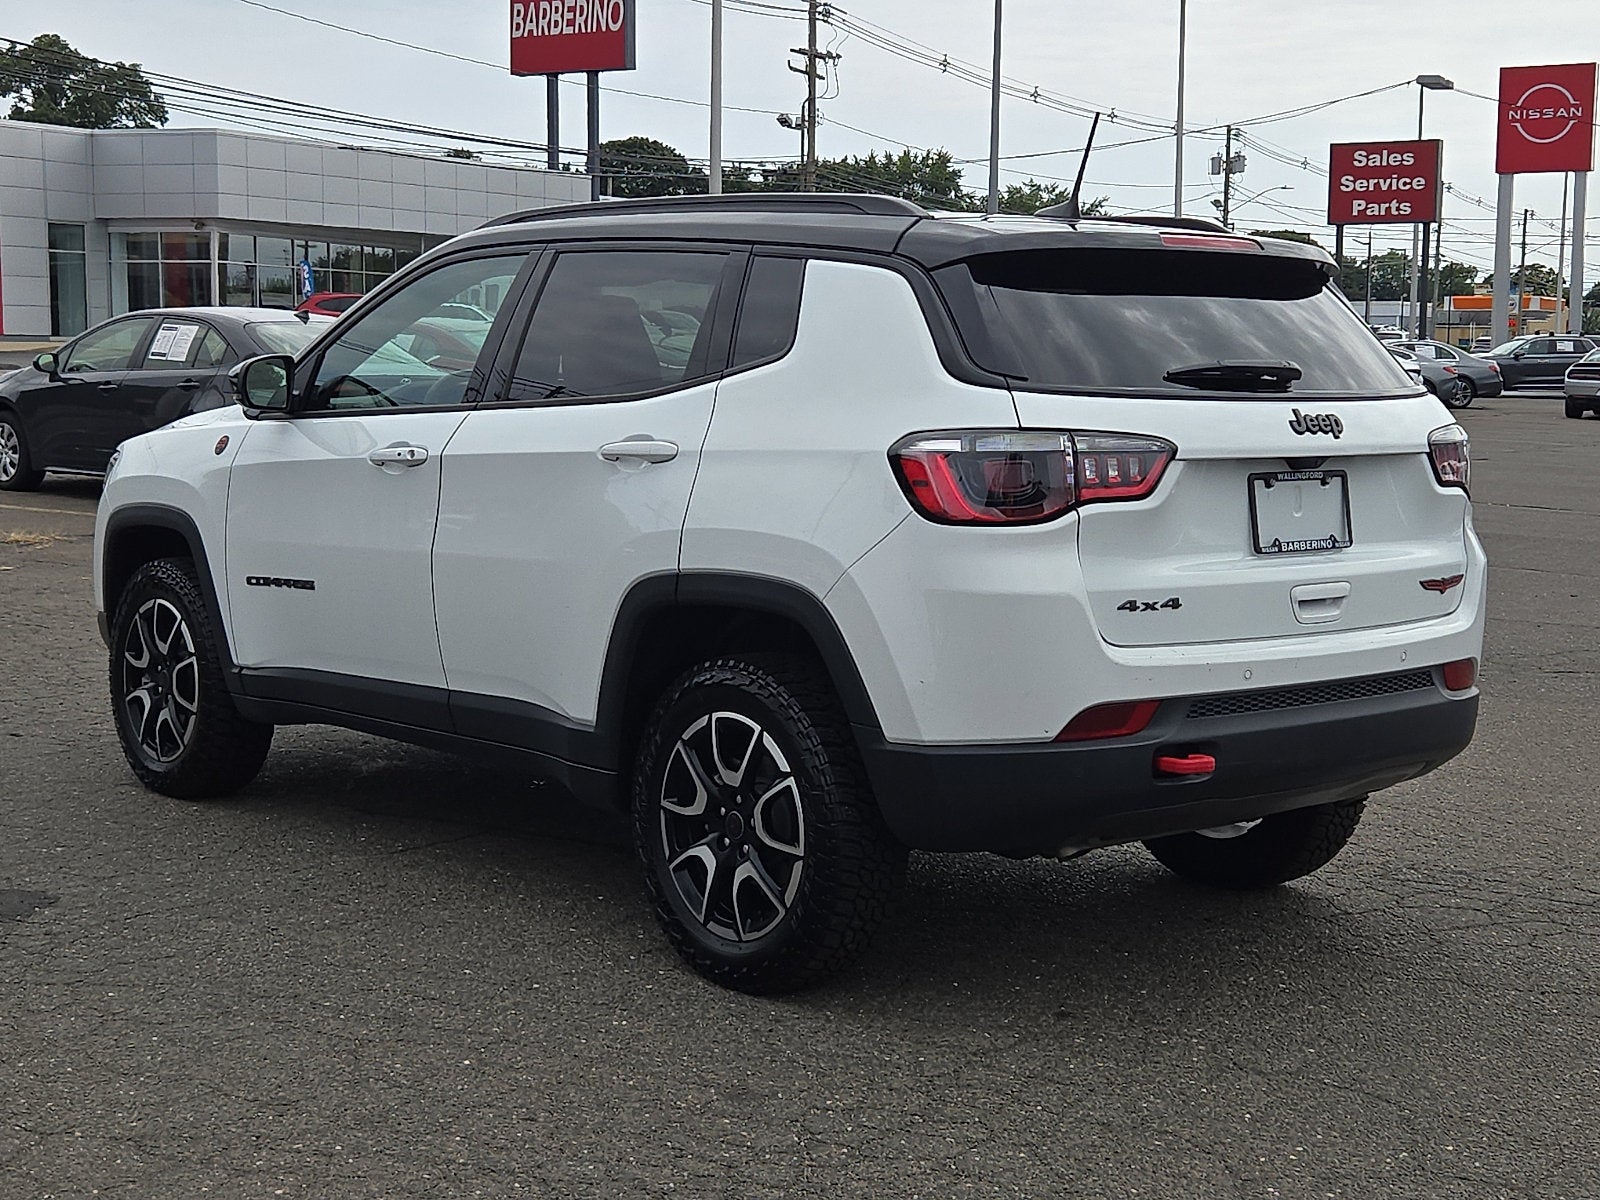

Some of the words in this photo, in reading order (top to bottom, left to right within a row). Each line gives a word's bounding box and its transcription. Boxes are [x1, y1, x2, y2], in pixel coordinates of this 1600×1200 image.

[512, 0, 624, 38] BARBERINO
[1508, 106, 1582, 120] NISSAN
[1353, 150, 1415, 167] Sales
[1340, 175, 1426, 192] Service
[1352, 199, 1412, 216] Parts
[1288, 408, 1343, 440] Jeep
[1277, 472, 1323, 480] WALLINGFORD
[1281, 540, 1333, 551] BARBERINO
[1117, 597, 1182, 612] 4x4
